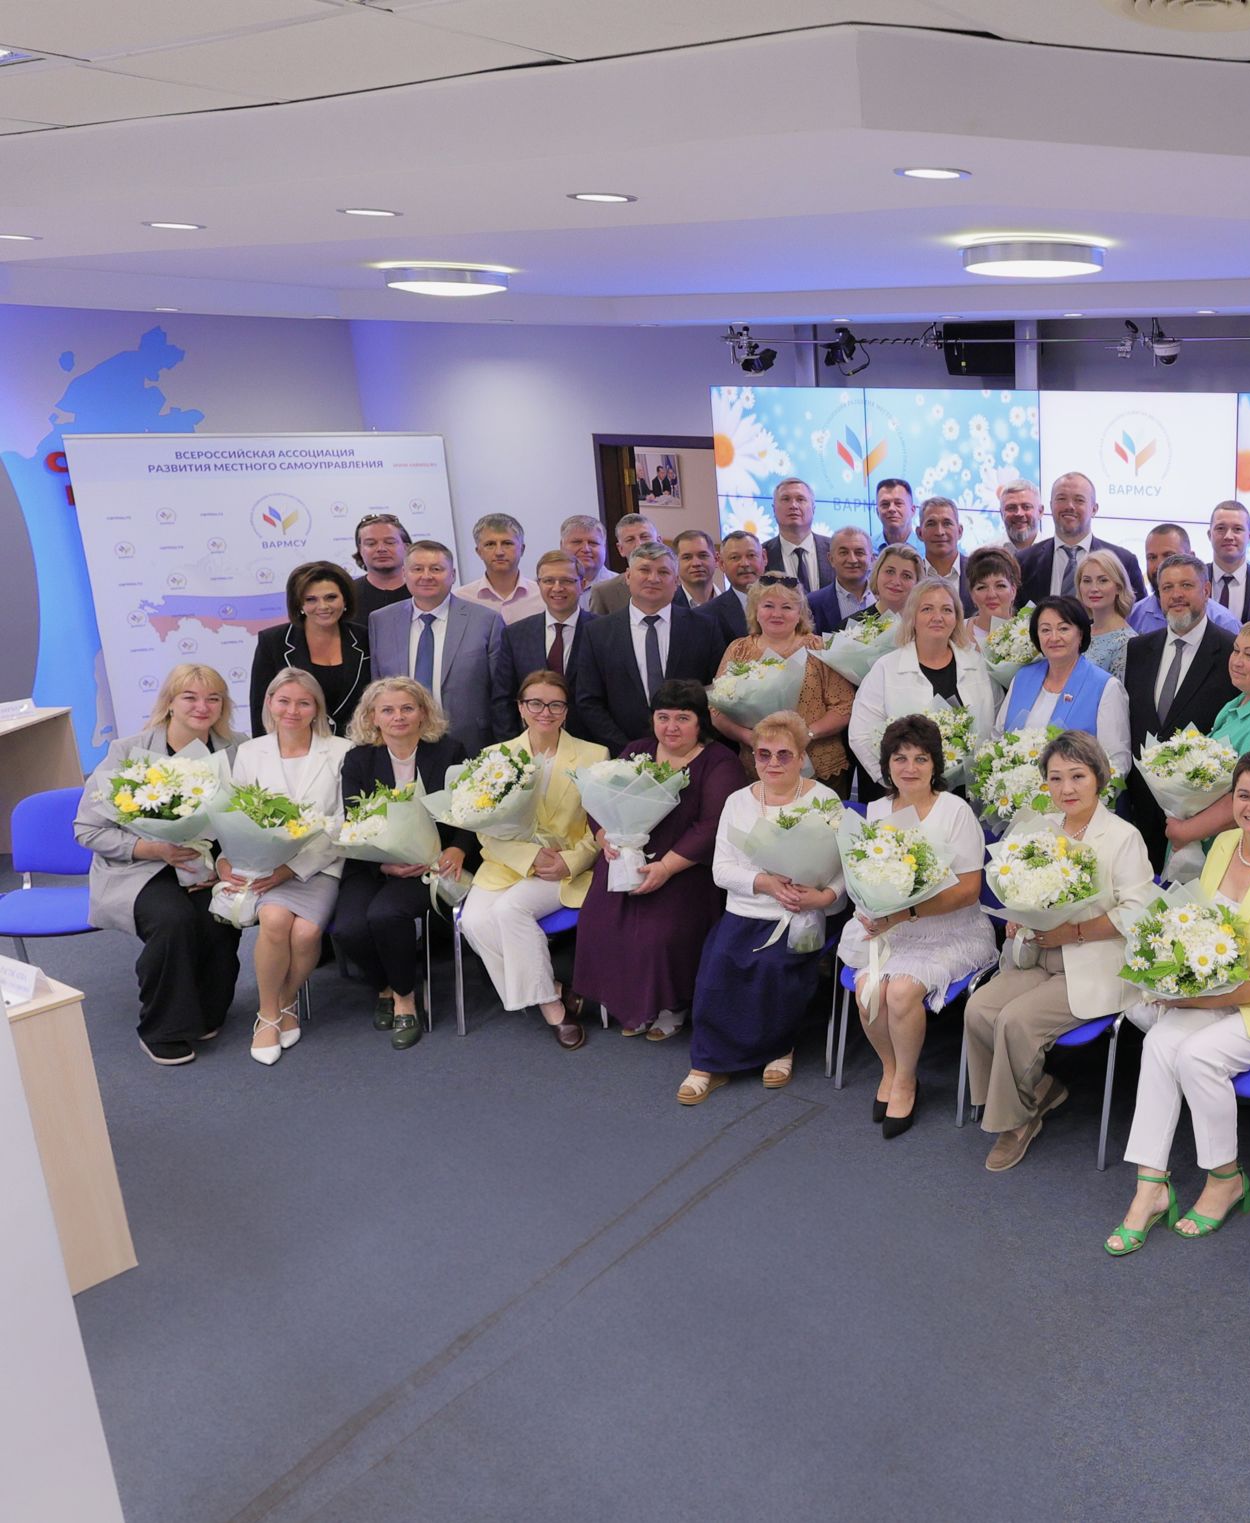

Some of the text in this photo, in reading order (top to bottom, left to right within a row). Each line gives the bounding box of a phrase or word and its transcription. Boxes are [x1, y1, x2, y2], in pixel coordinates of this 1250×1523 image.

[174, 448, 356, 461] ВСЕРОССИЙСКАЯ АССОЦИАЦИЯ
[147, 463, 212, 473] РАЗВИТИЯ
[213, 462, 278, 472] МЕСТНОГО
[278, 460, 385, 471] САМОУПРАВЛЕНИЯ
[1108, 484, 1162, 497] ВАРМСУ
[832, 496, 877, 513] ВАРМ
[261, 539, 308, 550] ВАРМСУ
